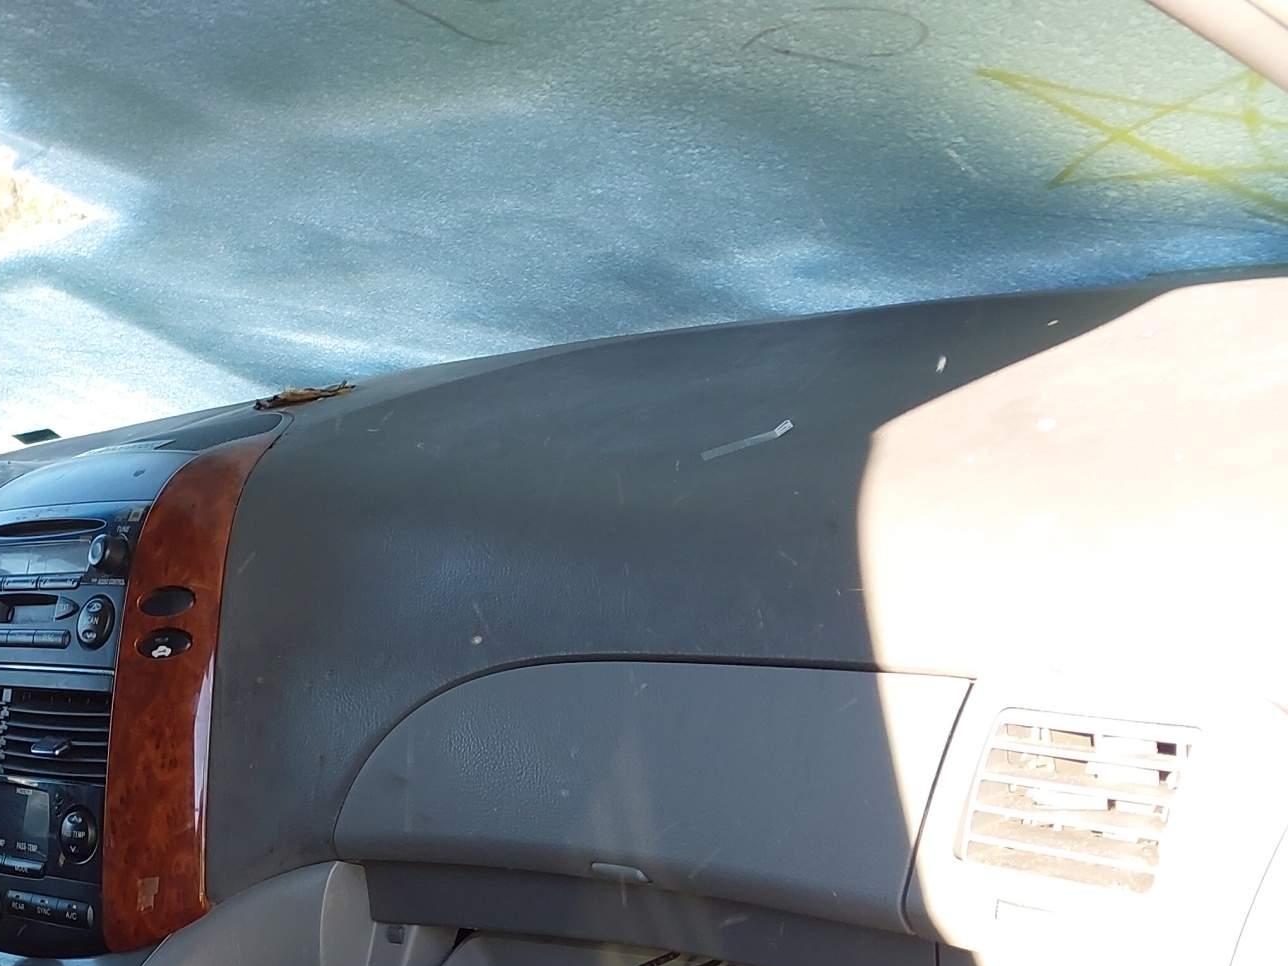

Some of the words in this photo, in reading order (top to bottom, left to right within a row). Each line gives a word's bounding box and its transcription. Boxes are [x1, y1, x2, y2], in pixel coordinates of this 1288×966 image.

[73, 831, 86, 839] TEMP
[27, 843, 38, 852] TEMP
[37, 906, 51, 917] SYNC
[65, 911, 78, 921] A/C
